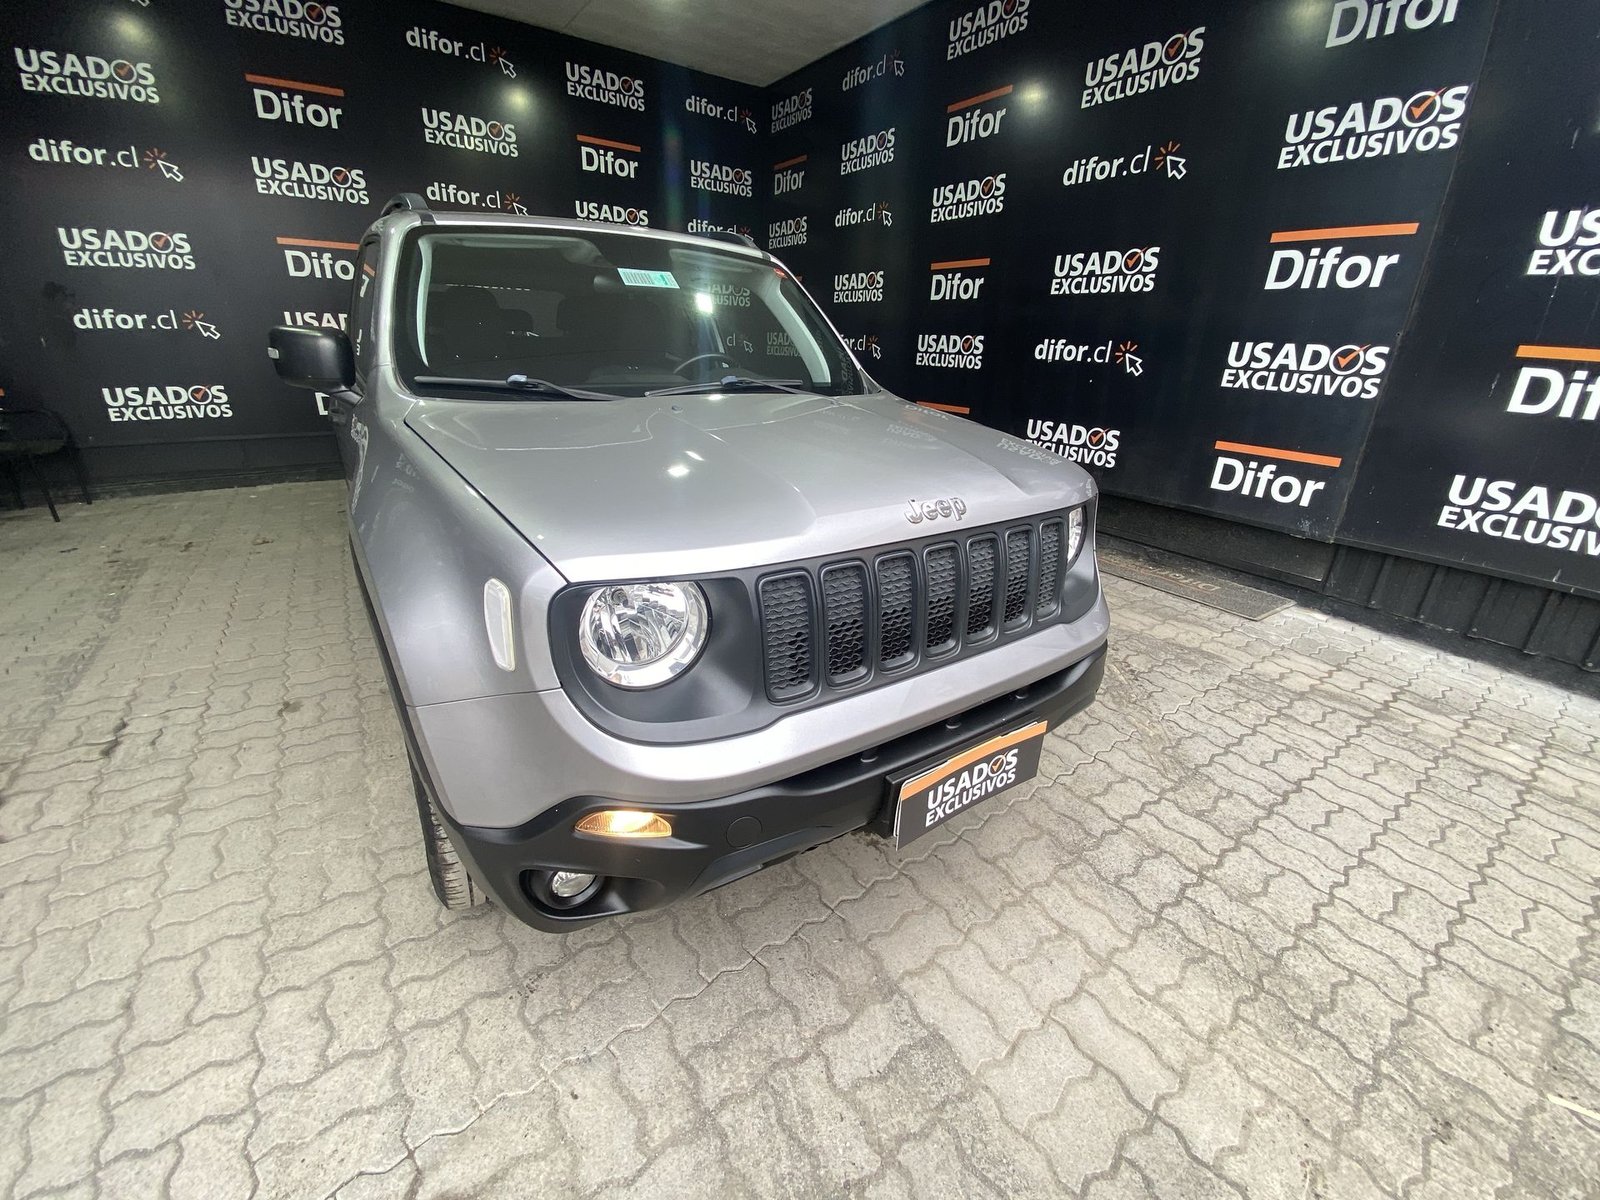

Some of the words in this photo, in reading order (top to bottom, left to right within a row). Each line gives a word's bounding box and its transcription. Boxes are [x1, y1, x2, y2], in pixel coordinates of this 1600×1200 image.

[225, 9, 345, 46] EXCLUSIVOS
[947, 12, 1029, 61] EXCLUSIVOS
[406, 27, 485, 62] difor.cl
[1085, 26, 1206, 87] USADOS
[14, 48, 156, 86] USADOS
[566, 61, 644, 97] USADOS
[842, 54, 886, 92] difor.cl
[20, 73, 160, 104] EXCLUSIVOS
[567, 81, 645, 112] EXCLUSIVOS
[1081, 58, 1201, 109] EXCLUSIVOS
[253, 88, 343, 129] Difor
[685, 96, 737, 122] difor.cl
[772, 87, 812, 121] USADOS
[772, 105, 812, 134] EXCLUSIVOS
[1284, 85, 1469, 144] USADOS
[422, 108, 517, 143] USADOS
[946, 108, 1007, 148] Difor
[28, 139, 139, 168] difor.cl
[425, 129, 518, 158] EXCLUSIVOS
[841, 127, 895, 161] USADOS
[1277, 123, 1461, 170] EXCLUSIVOS
[251, 156, 367, 189] USADOS
[581, 146, 638, 178] Difor
[690, 160, 752, 185] USADOS
[840, 147, 894, 175] EXCLUSIVOS
[1063, 145, 1151, 186] difor.cl
[255, 179, 370, 205] EXCLUSIVOS
[426, 182, 500, 209] difor.cl
[691, 177, 752, 197] EXCLUSIVOS
[774, 169, 804, 195] Difor
[932, 173, 1006, 207] USADOS
[575, 201, 648, 226] USADOS
[835, 203, 876, 227] difor.cl
[931, 196, 1004, 223] EXCLUSIVOS
[57, 227, 192, 254] USADOS
[687, 219, 737, 234] diforcl
[769, 216, 807, 238] USADOS
[769, 232, 807, 249] EXCLUSIVOS
[63, 251, 196, 270] EXCLUSIVOS
[284, 250, 355, 280] Difo
[1054, 246, 1160, 277] USADOS
[1264, 246, 1400, 290] Difor
[833, 288, 883, 303] EXCLUSIVOS
[834, 271, 884, 291] USADOS
[930, 273, 984, 300] Difor
[1050, 273, 1156, 295] EXCLUSIVOS
[73, 309, 178, 330] difor.cl
[918, 334, 984, 354] USADOS
[1034, 339, 1112, 363] difor.cl
[1227, 341, 1390, 376] USADOS
[915, 352, 982, 369] EXCLUSIVOS
[102, 385, 228, 406] USADOS
[1221, 369, 1381, 399] EXCLUSIVOS
[1506, 366, 1600, 421] Dif
[108, 404, 233, 422] EXCLUSIVOS
[1026, 418, 1121, 452] USADOS
[1025, 438, 1117, 469] LUSIVOS
[1210, 455, 1326, 508] Difor
[904, 497, 967, 524] Jeep
[1448, 474, 1600, 528] USAD
[1436, 505, 1600, 556] EXCLUSIV
[928, 749, 1018, 810] USADOS
[926, 768, 1016, 827] EXCLUSIVOS
